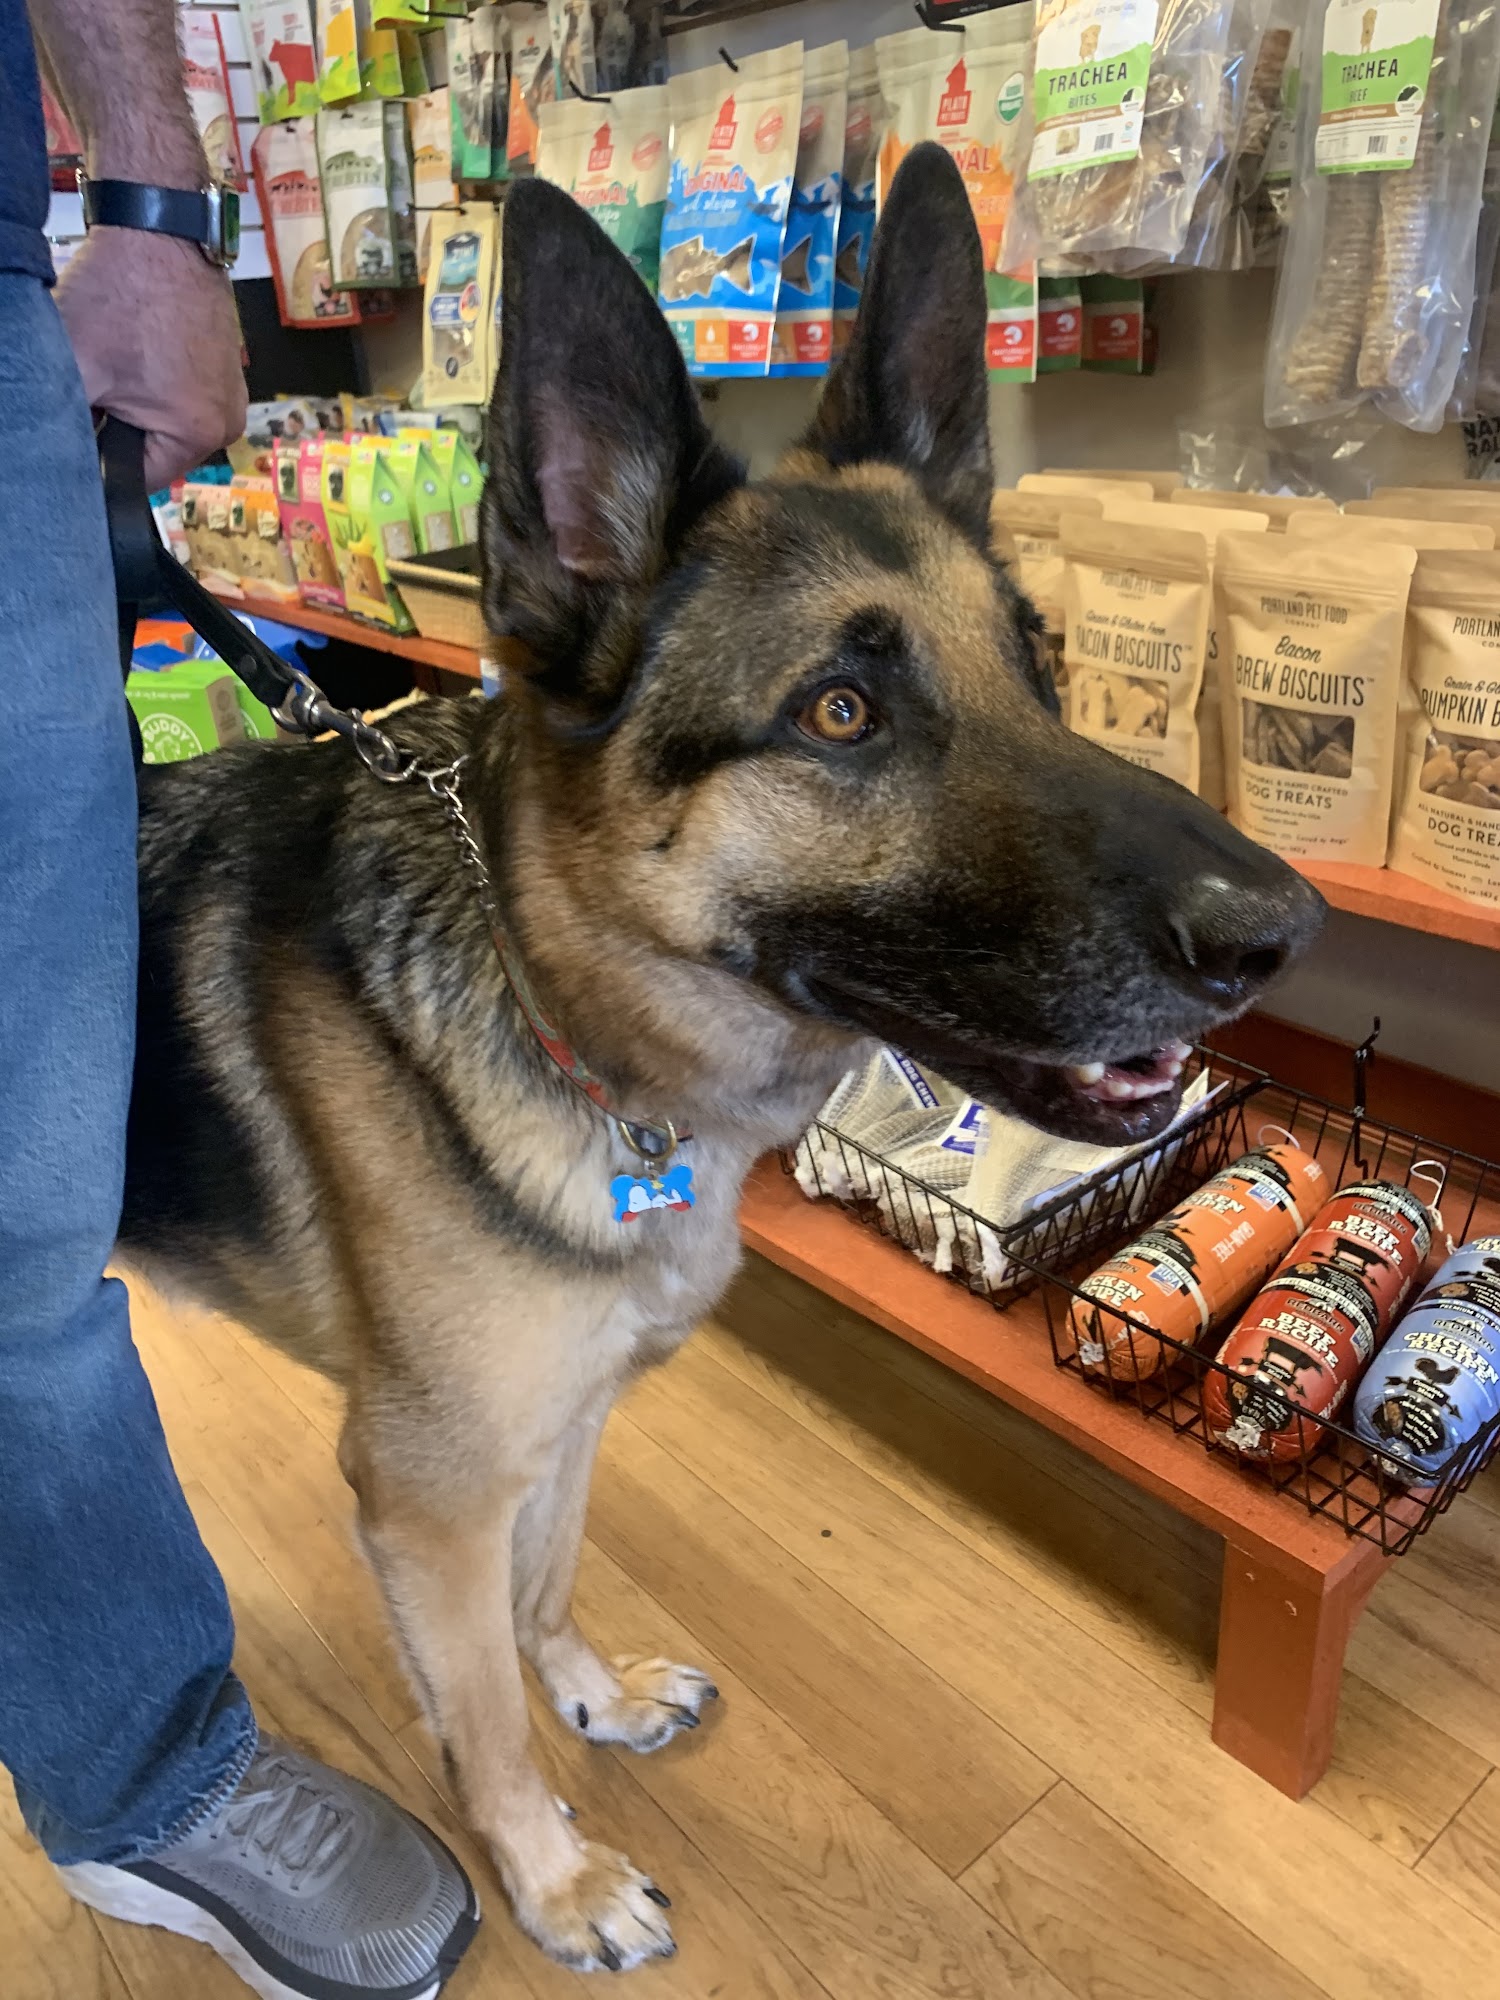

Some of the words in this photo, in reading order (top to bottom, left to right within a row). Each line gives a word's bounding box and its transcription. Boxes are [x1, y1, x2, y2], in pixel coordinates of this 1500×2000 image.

[1049, 62, 1127, 96] TRACHEA
[1341, 58, 1398, 84] TRACHEA
[1068, 93, 1097, 109] BITES
[1260, 596, 1304, 617] PORTLAND
[1306, 602, 1322, 621] PET
[1325, 605, 1348, 624] FOOD
[1453, 616, 1500, 638] PORTLAN
[1275, 635, 1322, 663] Bacon
[1236, 654, 1277, 693] BREW
[1444, 676, 1473, 691] Grain
[1474, 680, 1486, 692] &
[1422, 688, 1488, 725] PUMPKIN
[143, 718, 190, 743] BUDDY
[1246, 781, 1270, 800] DOG
[1276, 790, 1332, 809] TREATS
[1311, 784, 1348, 797] CRAFTED
[1430, 807, 1465, 823] NATURAL
[1427, 816, 1461, 837] DOG
[1467, 827, 1500, 847] TRE
[901, 1059, 918, 1082] DOG
[1327, 1220, 1403, 1266] RECIPE
[1345, 1214, 1400, 1245] BEEF
[1160, 1267, 1179, 1289] USA
[1287, 1297, 1346, 1335] REDBARN
[1439, 1303, 1475, 1317] PREMIUM
[1277, 1312, 1337, 1345] BEEF
[1432, 1318, 1496, 1355] REDBARN
[1259, 1318, 1339, 1368] RECIPE
[1403, 1332, 1499, 1385] CHICKEN
[1408, 1339, 1487, 1385] RECIPE
[1413, 1379, 1444, 1399] Complete
[1417, 1387, 1435, 1399] Meal
